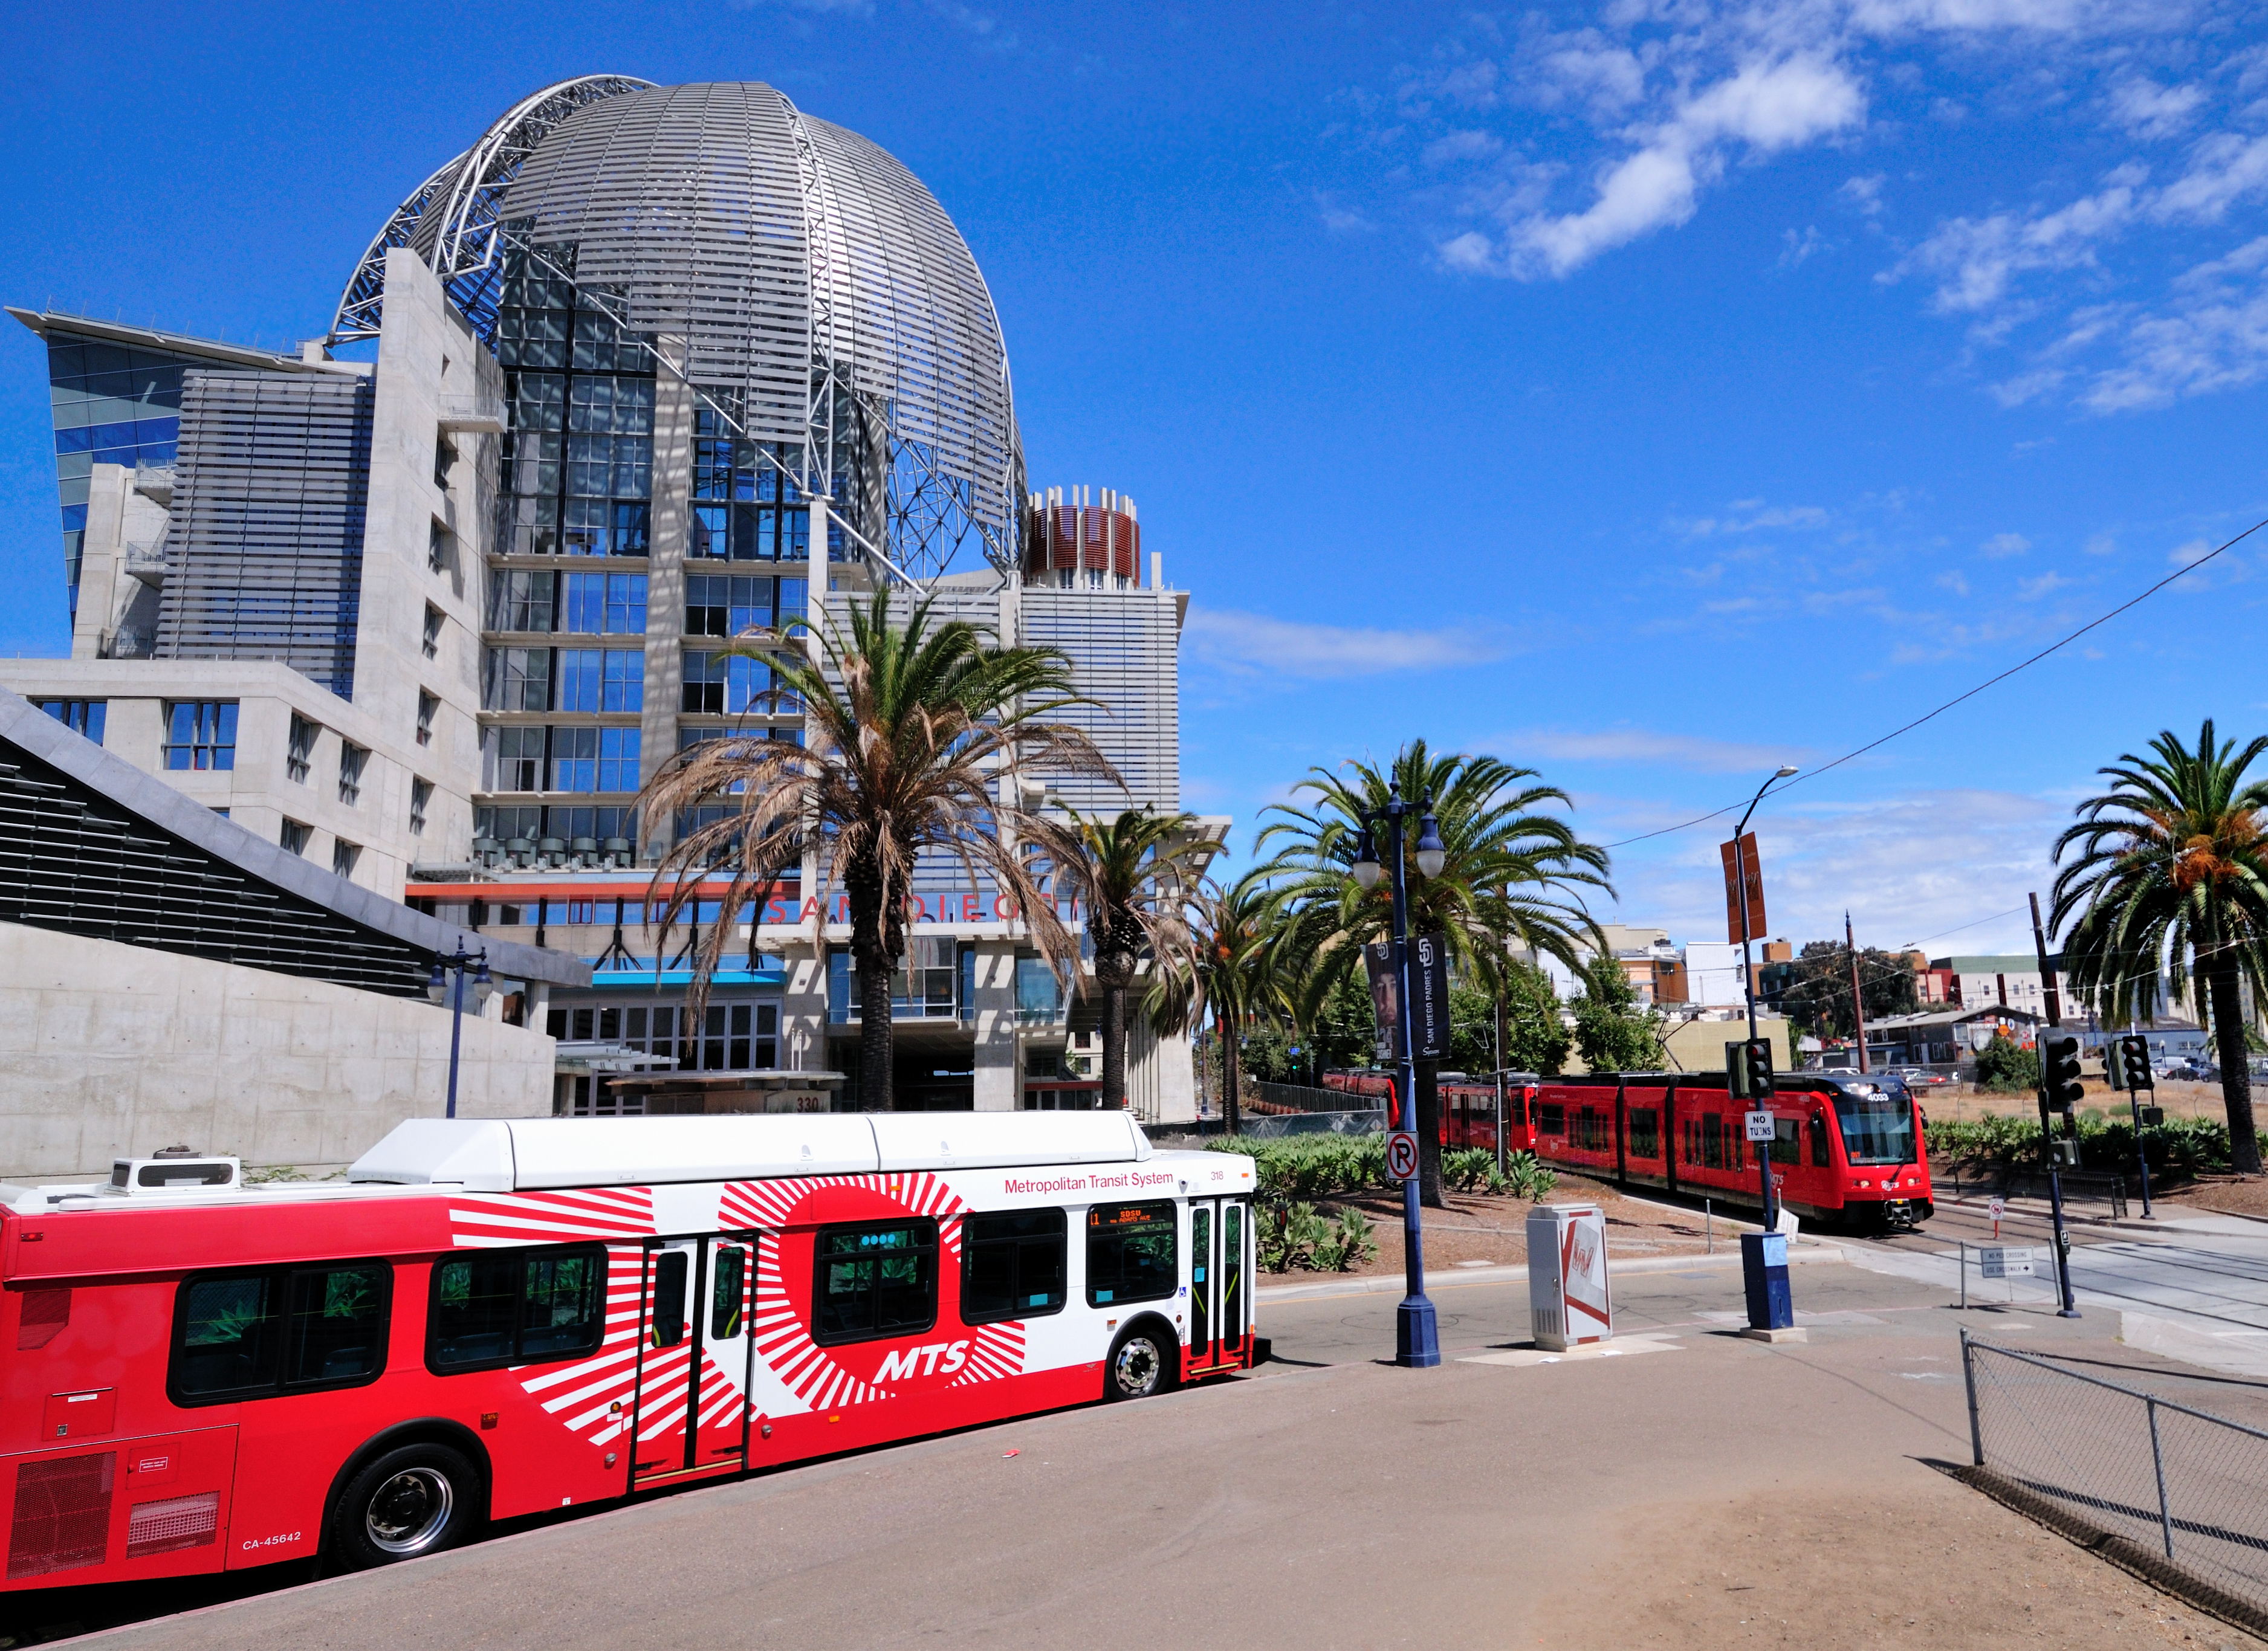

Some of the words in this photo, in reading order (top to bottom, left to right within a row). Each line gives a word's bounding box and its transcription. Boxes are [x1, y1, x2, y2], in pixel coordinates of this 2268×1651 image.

[1424, 969, 1433, 1001] PADRES
[1426, 1002, 1434, 1026] DIEGO
[797, 1097, 818, 1112] 330
[1750, 1126, 1771, 1136] TUNS
[1005, 1177, 1086, 1194] Metropolitan
[1089, 1174, 1128, 1189] Transit
[1132, 1172, 1173, 1189] System
[1211, 1171, 1223, 1180] 318
[872, 1340, 970, 1384] MTS
[242, 1531, 301, 1550] CA-45642
